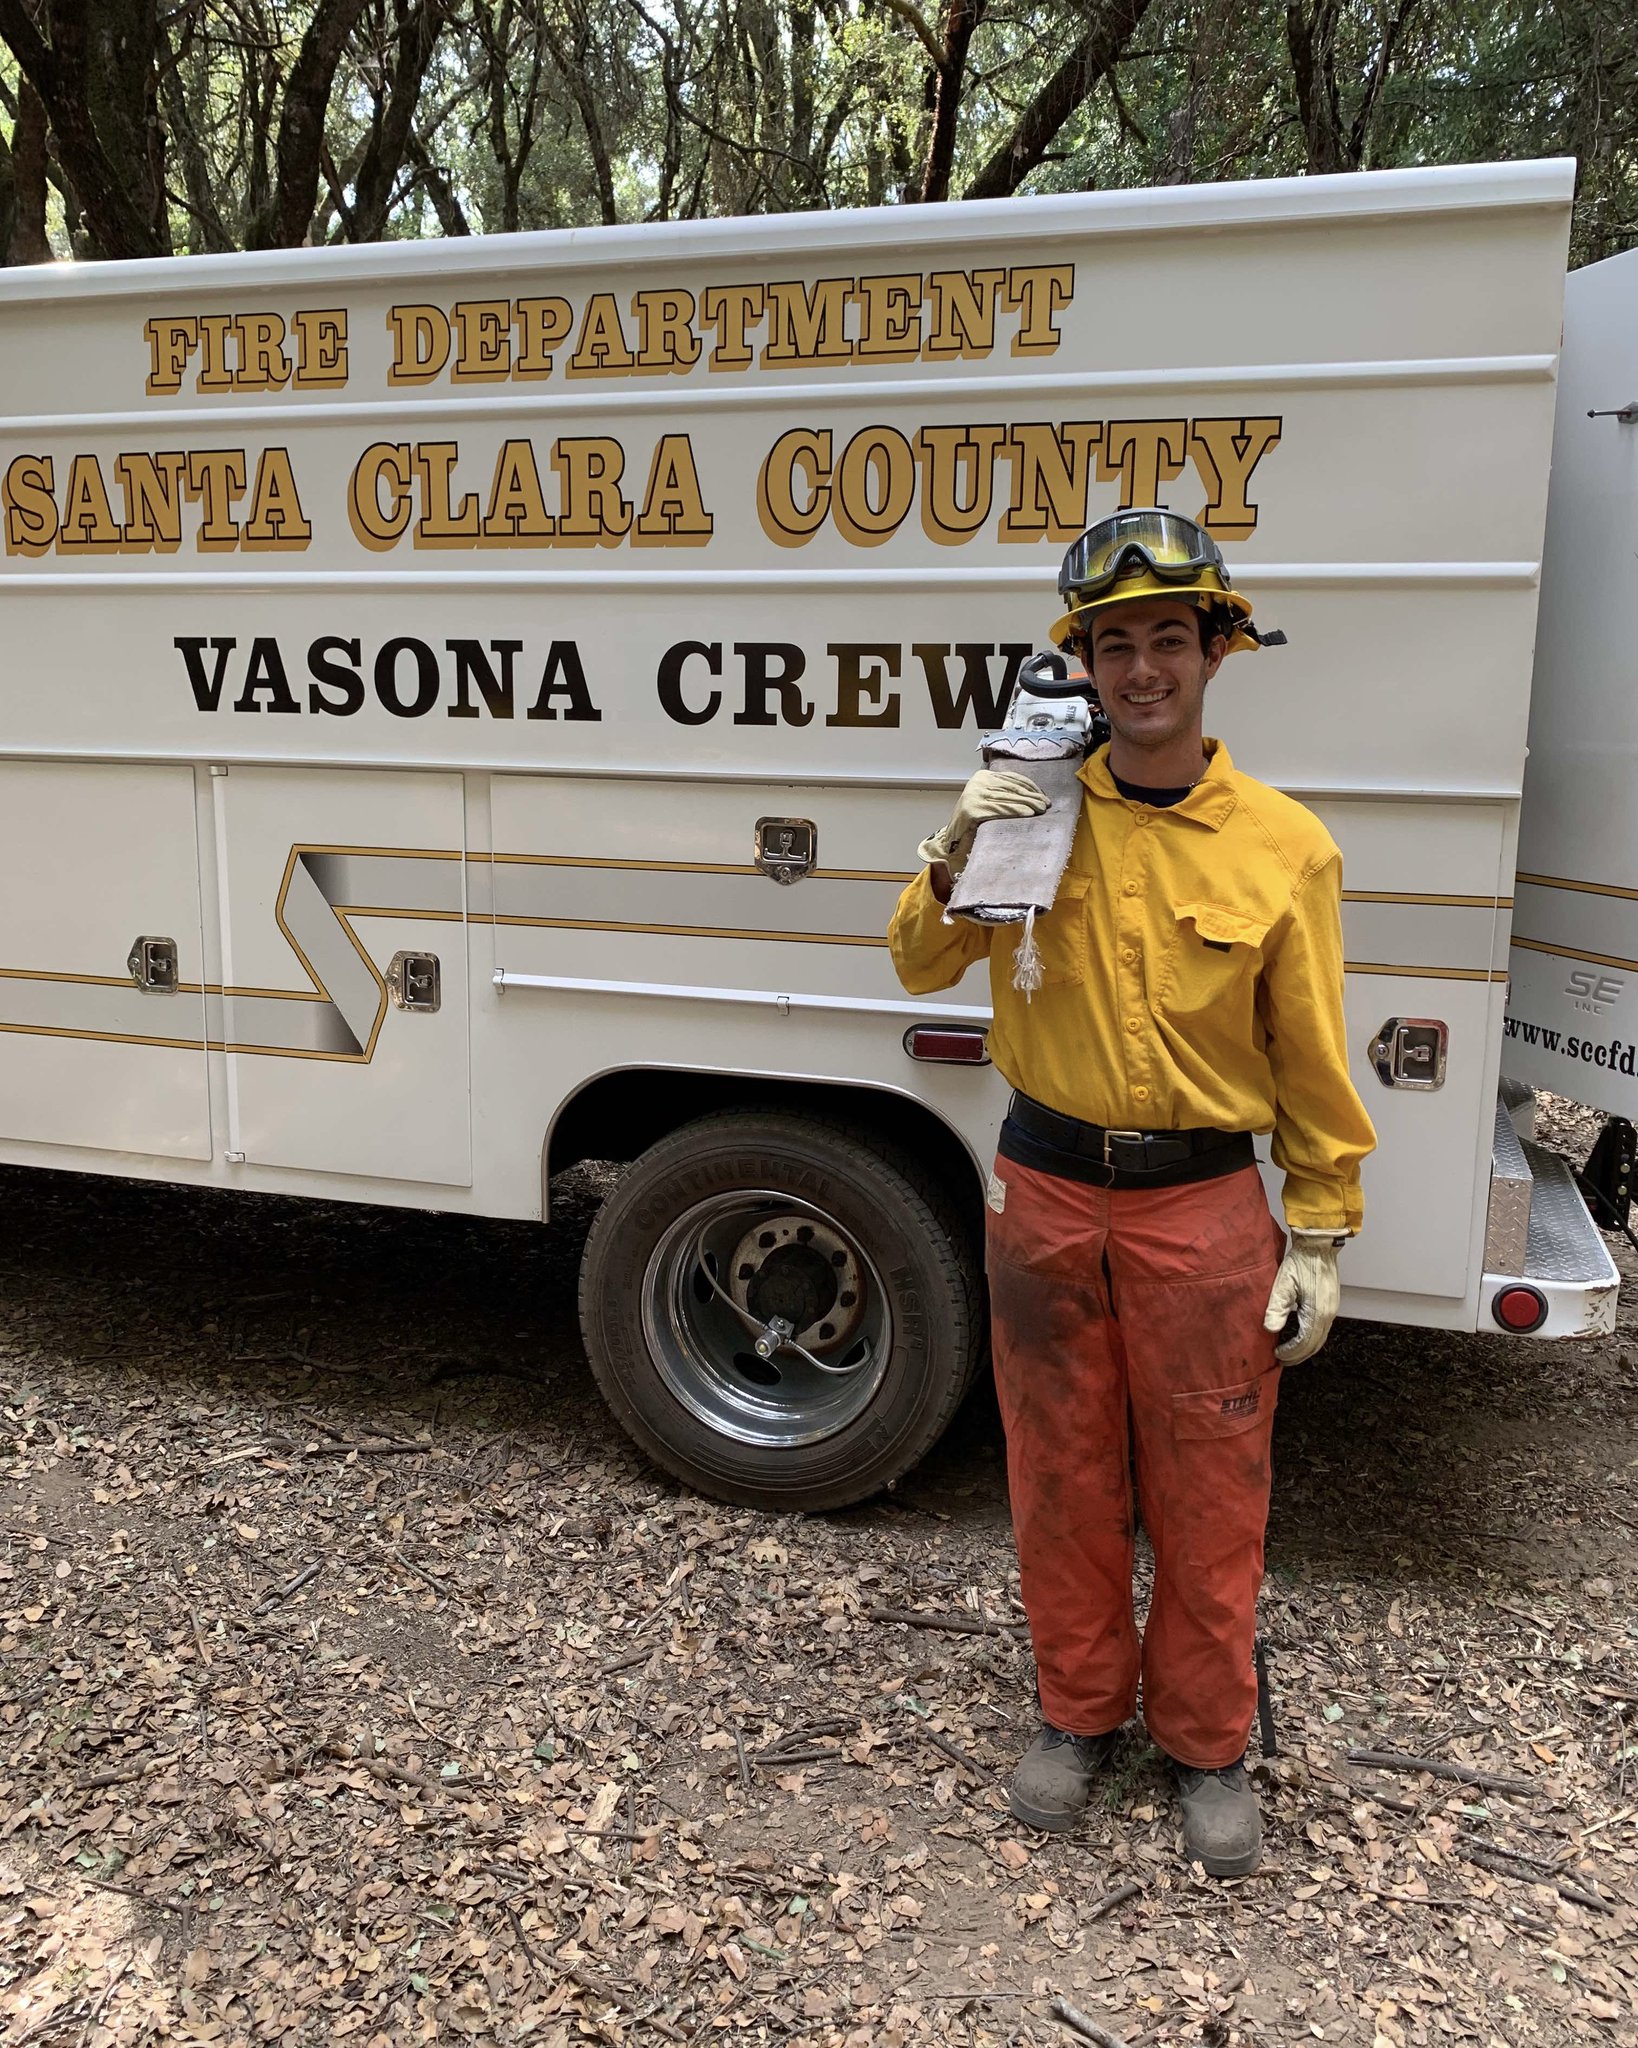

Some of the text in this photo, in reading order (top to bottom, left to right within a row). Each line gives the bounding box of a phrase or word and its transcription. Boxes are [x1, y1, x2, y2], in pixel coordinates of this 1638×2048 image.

[144, 263, 1075, 396] FIRE DEPARTMENT
[3, 415, 1283, 557] SANTA CLARA COUNTY
[173, 636, 1034, 729] VASONA CREW
[1563, 970, 1625, 1006] SE
[1574, 1001, 1604, 1016] INC
[1503, 1016, 1638, 1077] www.sccfd
[635, 1158, 832, 1230] CONTINENTAL
